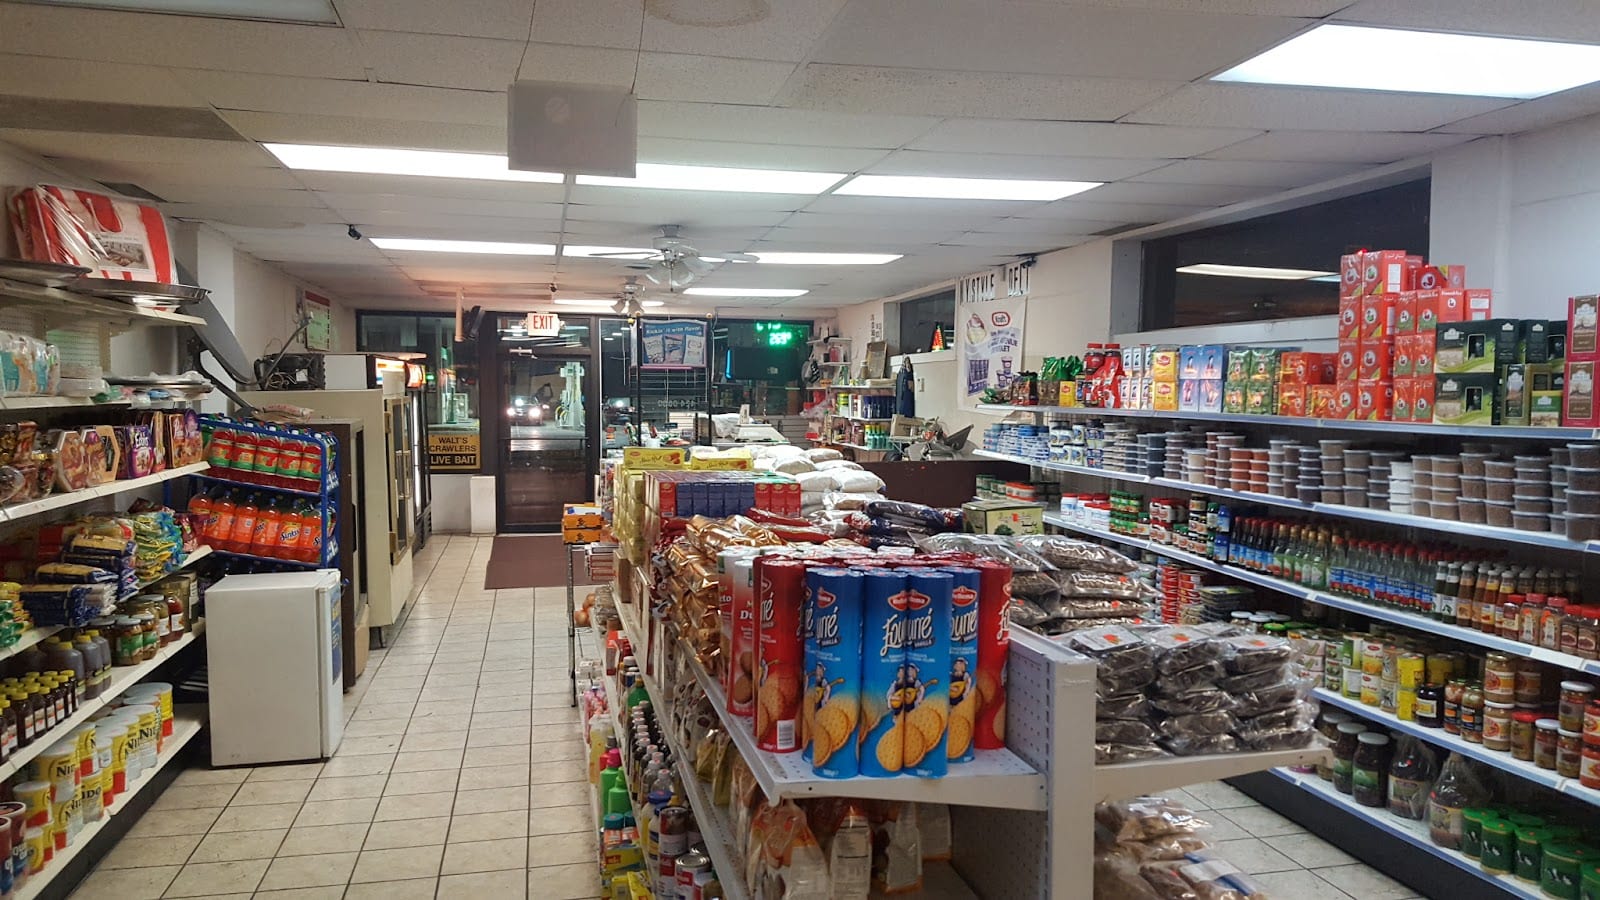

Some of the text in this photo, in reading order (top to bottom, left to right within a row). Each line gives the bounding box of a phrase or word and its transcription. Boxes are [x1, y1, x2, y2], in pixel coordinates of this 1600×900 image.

[533, 315, 553, 329] EXIT
[431, 456, 475, 465] LIVE BAIT
